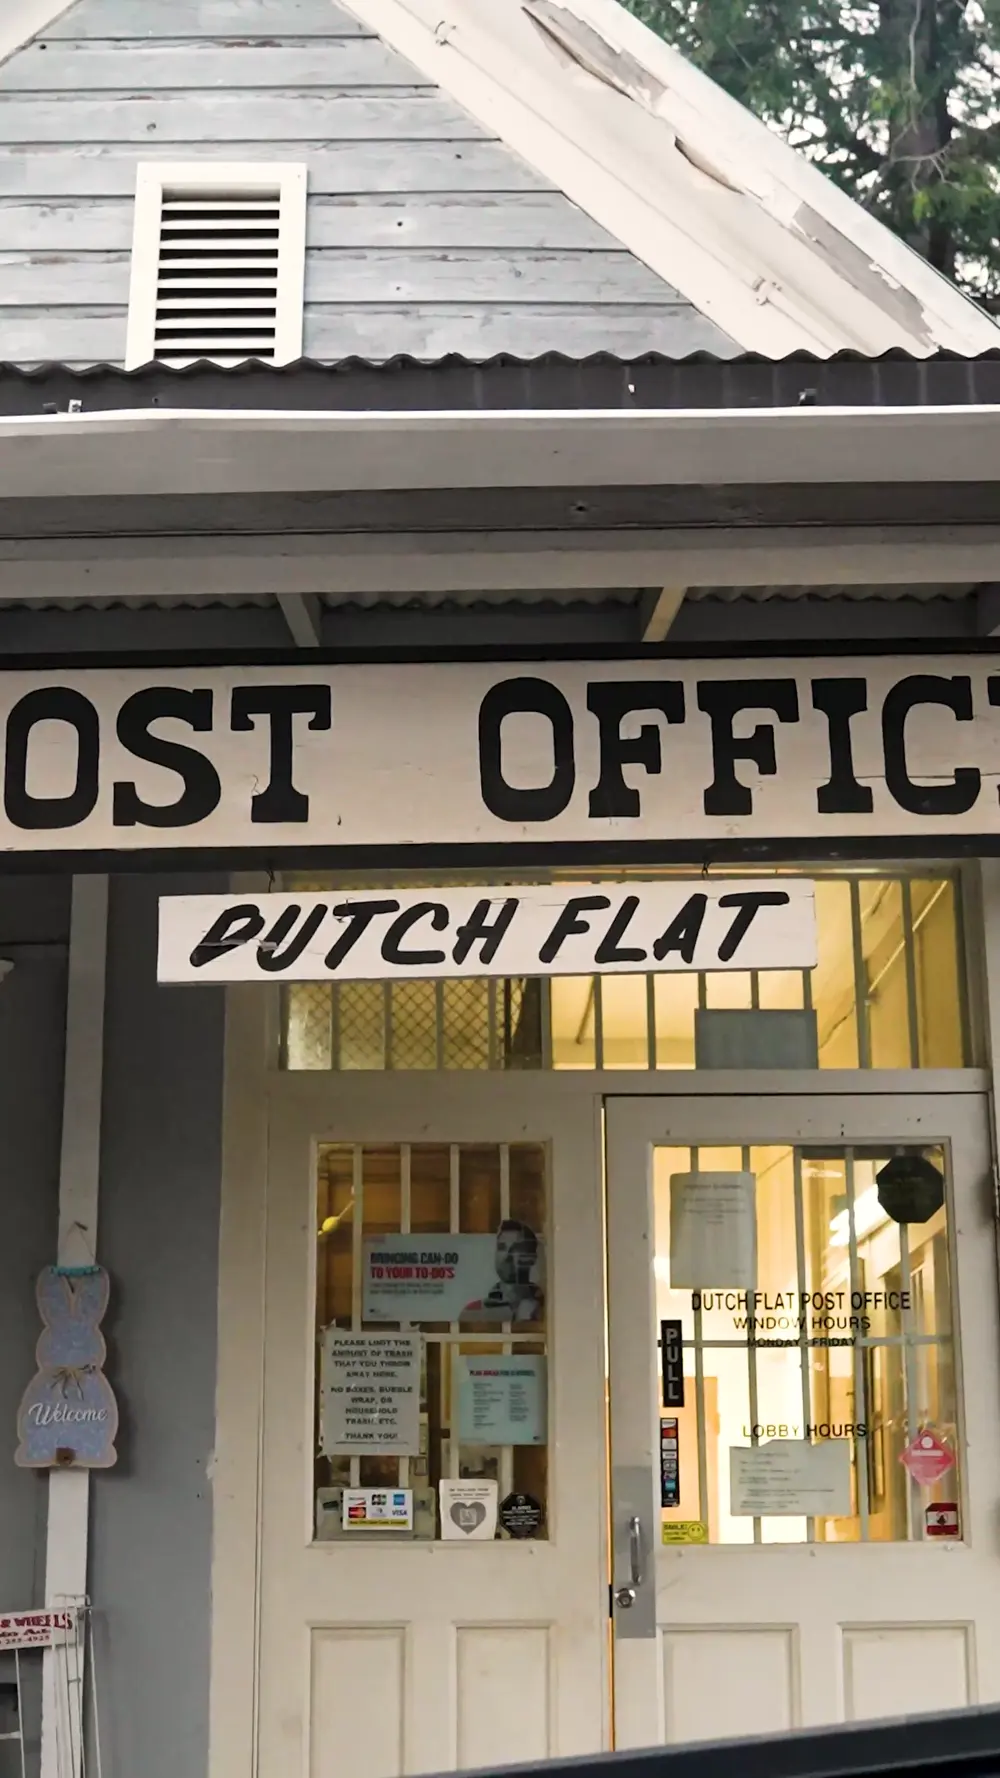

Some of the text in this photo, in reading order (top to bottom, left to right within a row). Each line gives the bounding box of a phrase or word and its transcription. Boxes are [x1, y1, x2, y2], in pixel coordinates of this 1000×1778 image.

[478, 674, 1000, 820] OFFIC
[189, 891, 790, 971] DUTCH FLAT
[420, 1252, 459, 1265] CAN-DO
[370, 1266, 456, 1279] TO YOUR TO-DO'S
[691, 1291, 911, 1310] DUTCH FLAT POST OFFICE
[733, 1316, 871, 1330] WINDOW HOURS
[333, 1339, 411, 1347] PLEASE LIMIT THE
[747, 1338, 800, 1347] MONDAY
[812, 1337, 857, 1347] FRIDAY
[331, 1350, 368, 1358] AMOUNT
[333, 1360, 357, 1368] THAT
[664, 1327, 681, 1401] PULL
[345, 1371, 371, 1379] AWAY
[28, 1402, 107, 1425] Welcome
[344, 1432, 375, 1440] THANK
[742, 1423, 867, 1437] LOBBY HOURS
[391, 1509, 408, 1517] VISA
[13, 1613, 73, 1630] WHEELS
